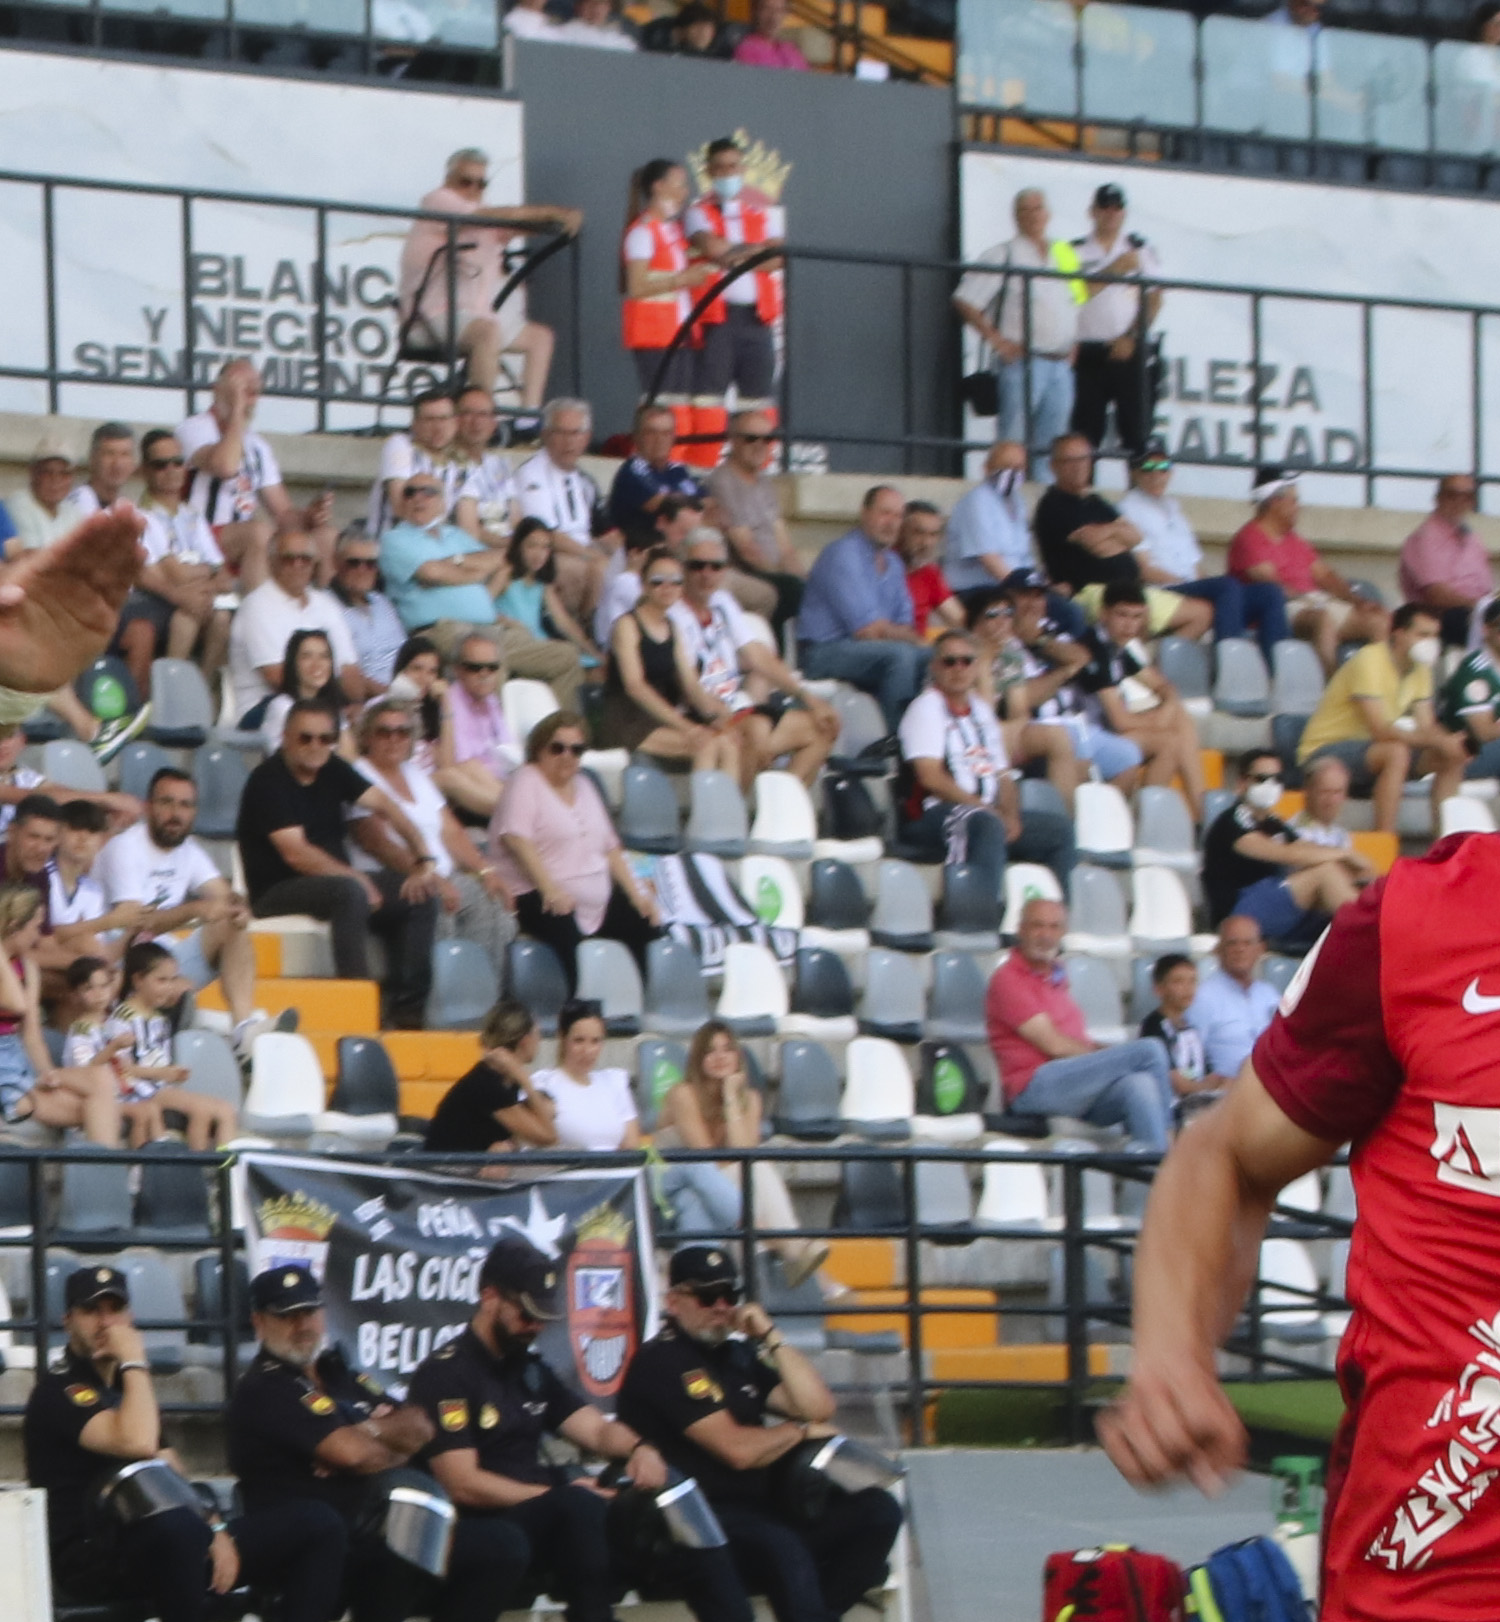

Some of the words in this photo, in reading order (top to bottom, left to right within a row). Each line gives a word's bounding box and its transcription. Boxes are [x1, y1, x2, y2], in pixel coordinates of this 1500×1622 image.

[191, 252, 400, 310] BLANC
[141, 305, 169, 343] Y
[192, 305, 391, 358] NEGRO
[350, 1250, 419, 1304] LAS
